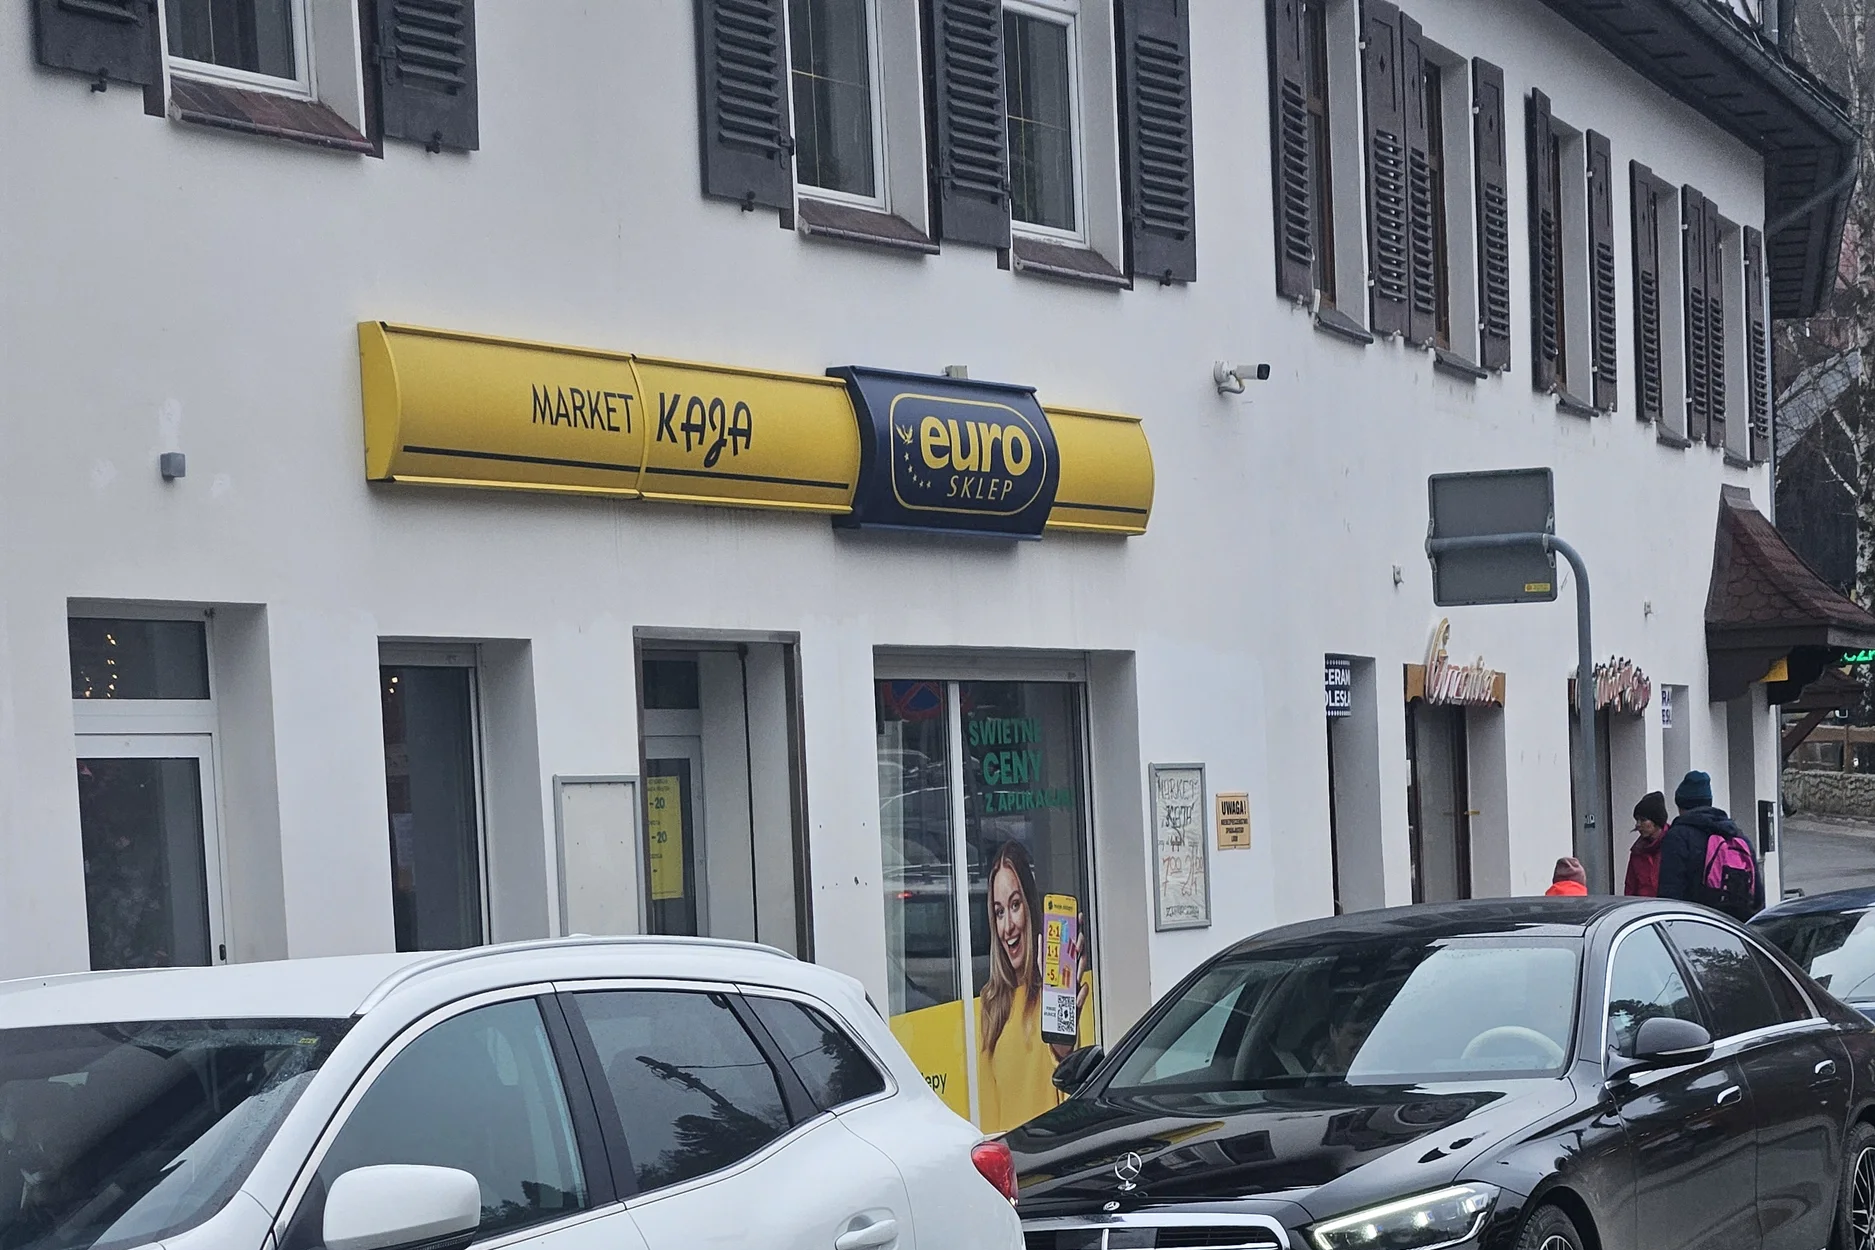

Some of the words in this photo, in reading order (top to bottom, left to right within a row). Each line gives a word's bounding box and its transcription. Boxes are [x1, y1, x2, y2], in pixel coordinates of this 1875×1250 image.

[531, 383, 634, 434] MARKET
[656, 391, 752, 468] KAJA
[920, 416, 1032, 476] euro
[947, 475, 1013, 501] SKLEP
[983, 750, 1043, 785] CENY
[1221, 800, 1247, 816] UWAGA!
[921, 1072, 947, 1095] epy
